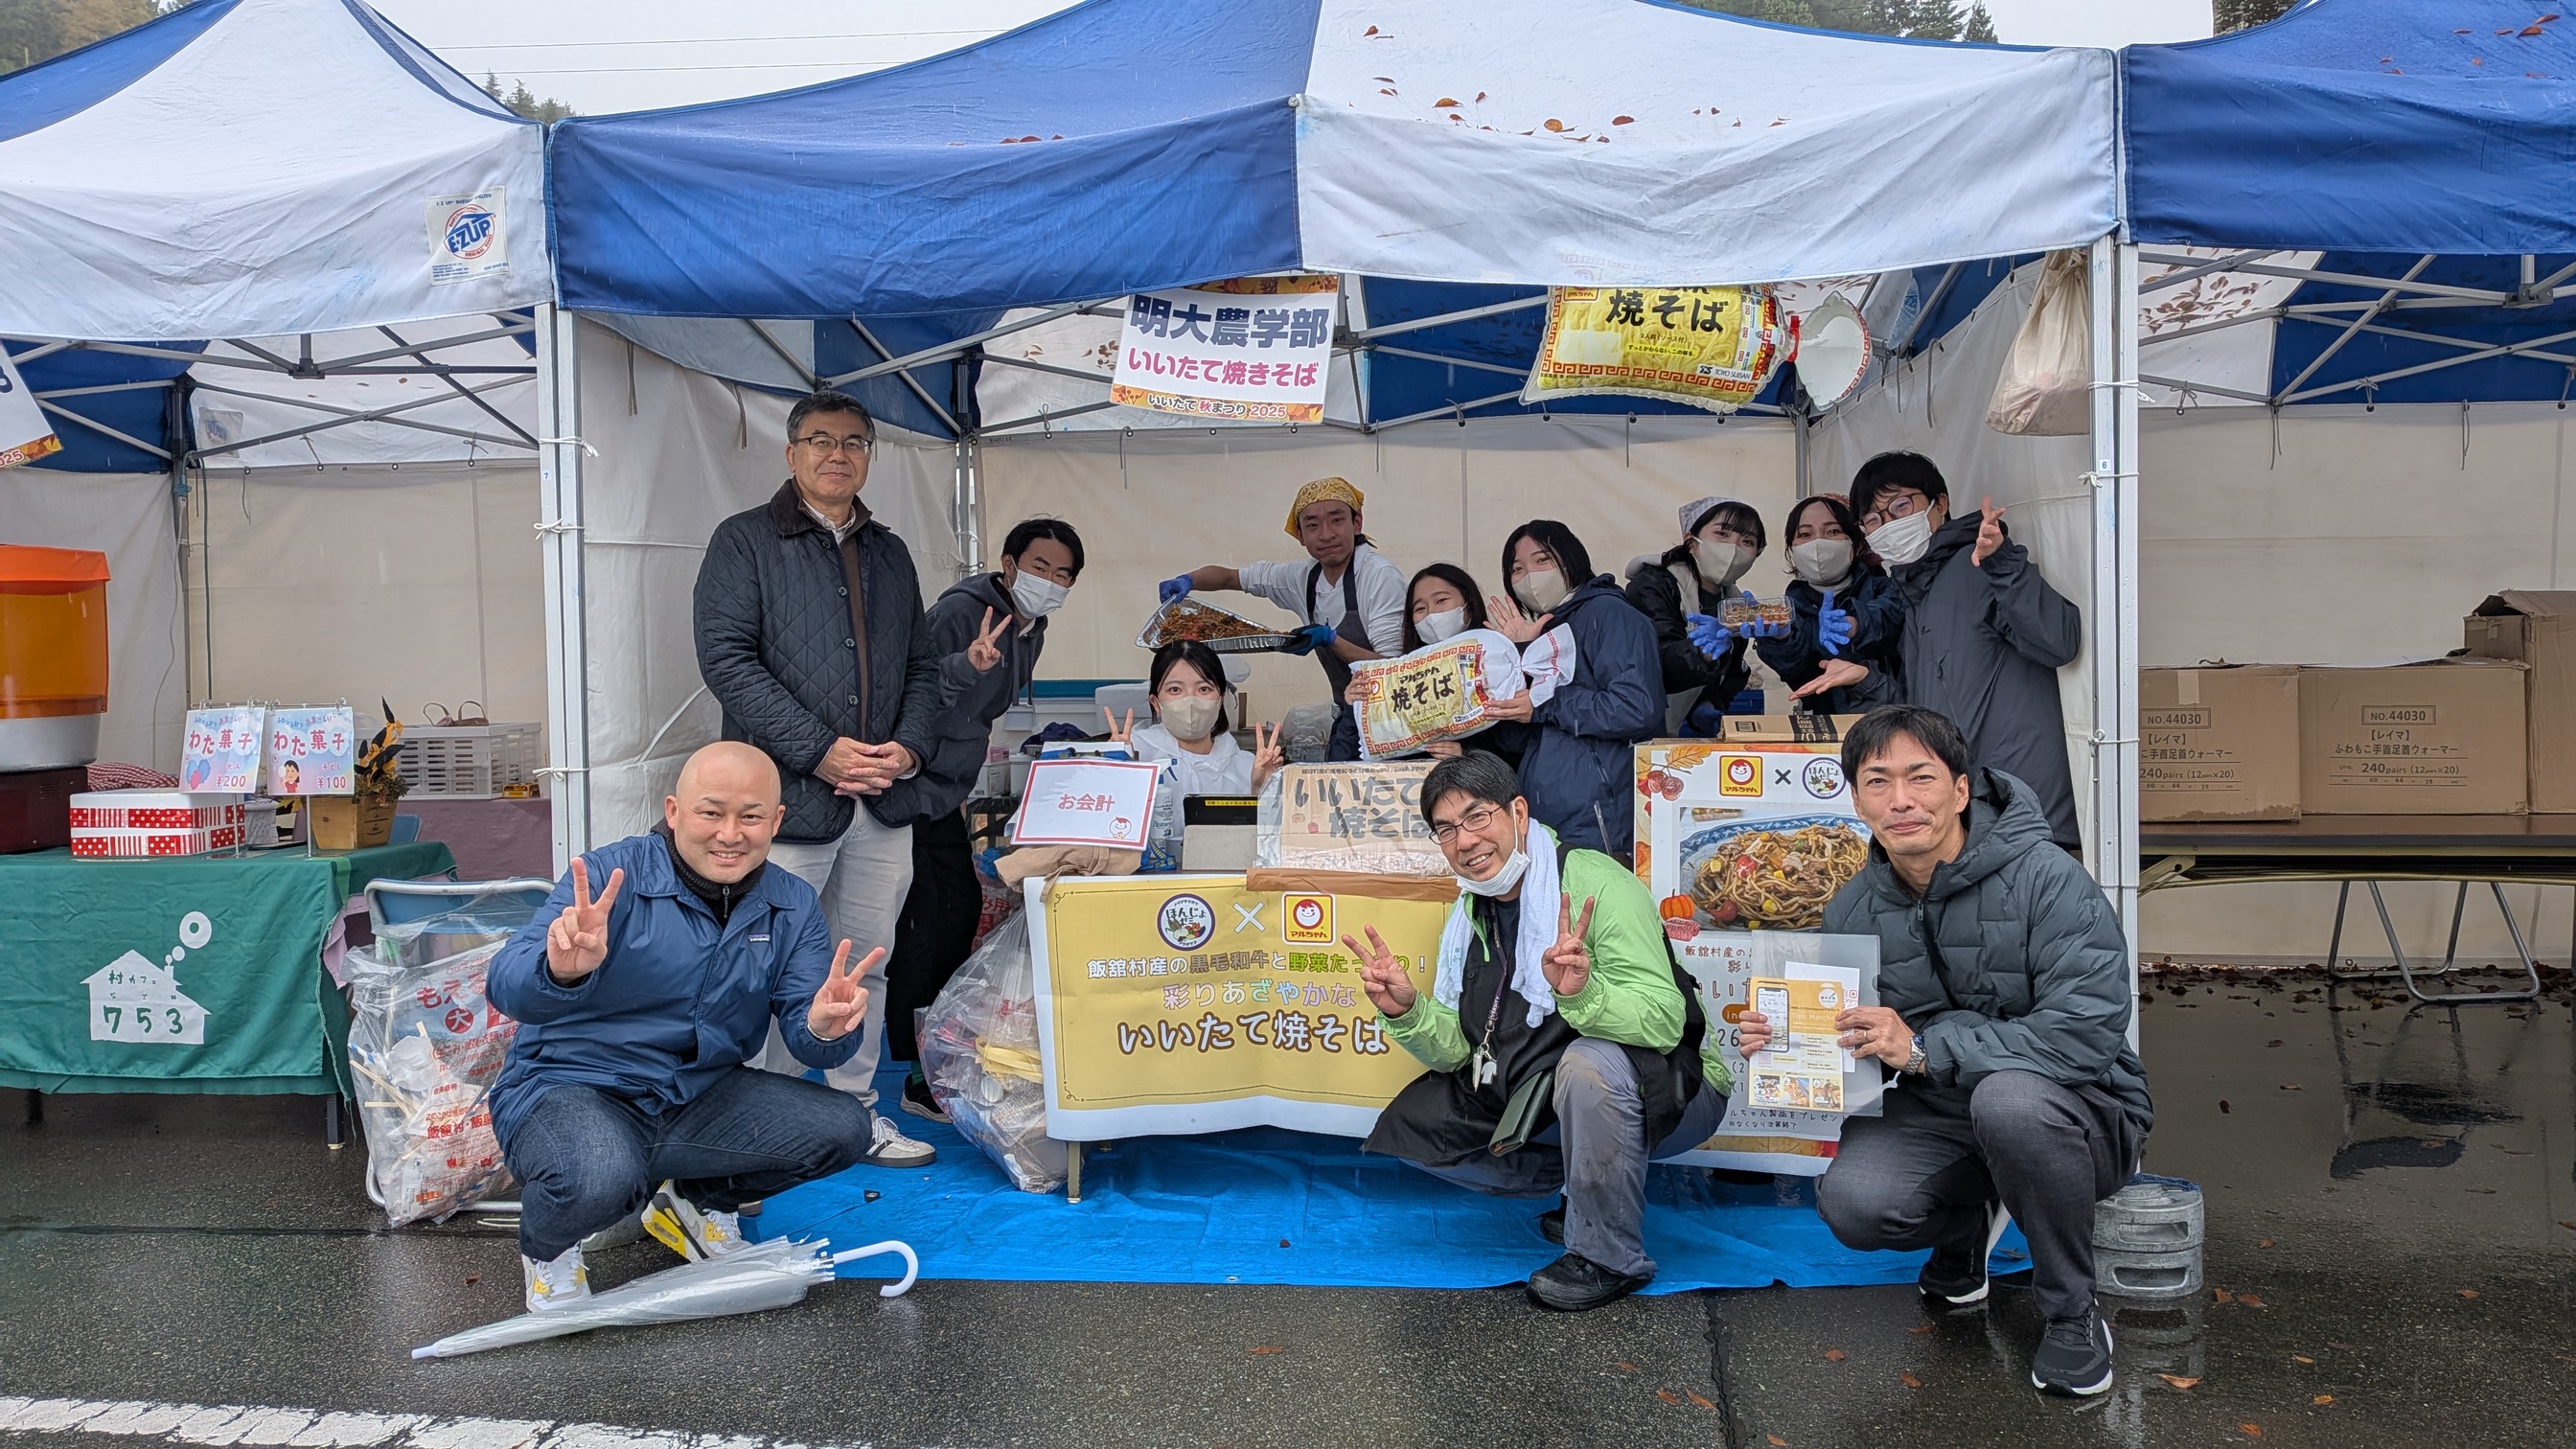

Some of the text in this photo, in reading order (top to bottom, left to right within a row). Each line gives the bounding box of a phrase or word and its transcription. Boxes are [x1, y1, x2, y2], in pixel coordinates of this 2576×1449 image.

[1605, 289, 1729, 333] 焼そば
[1130, 293, 1330, 349] 明大農学部
[1128, 347, 1320, 387] いいたて焼きそば
[1148, 393, 1287, 418] いいたて 秋まつり 2025
[543, 472, 549, 480] 7
[1399, 666, 1440, 684] マルちゃん
[1391, 671, 1456, 713] 焼そば
[2147, 714, 2201, 724] NO.44030
[2371, 710, 2426, 721] NO.44030
[189, 728, 252, 755] わた菓子
[274, 729, 344, 756] わた菓子
[2147, 733, 2186, 745] 【レイマ】
[2371, 729, 2409, 741] 【レイマ】
[2334, 744, 2459, 755] ふわもこ手首足首ウォーマー
[1808, 767, 1840, 776] ほんじょ
[217, 775, 246, 788] ¥200
[317, 776, 346, 789] ¥100
[1295, 777, 1425, 808] いいたて
[1057, 794, 1116, 813] お会計
[1165, 908, 1207, 918] ほんじょ
[1290, 931, 1327, 939] マルちゃん
[1685, 945, 1752, 958] 飯舘村産の
[1087, 950, 1426, 979] 飯舘村産の黒毛和牛と野菜たっり！
[108, 969, 156, 985] 村カフェ
[1162, 978, 1357, 1010] 彩りあざやかな
[448, 1010, 471, 1031] 大
